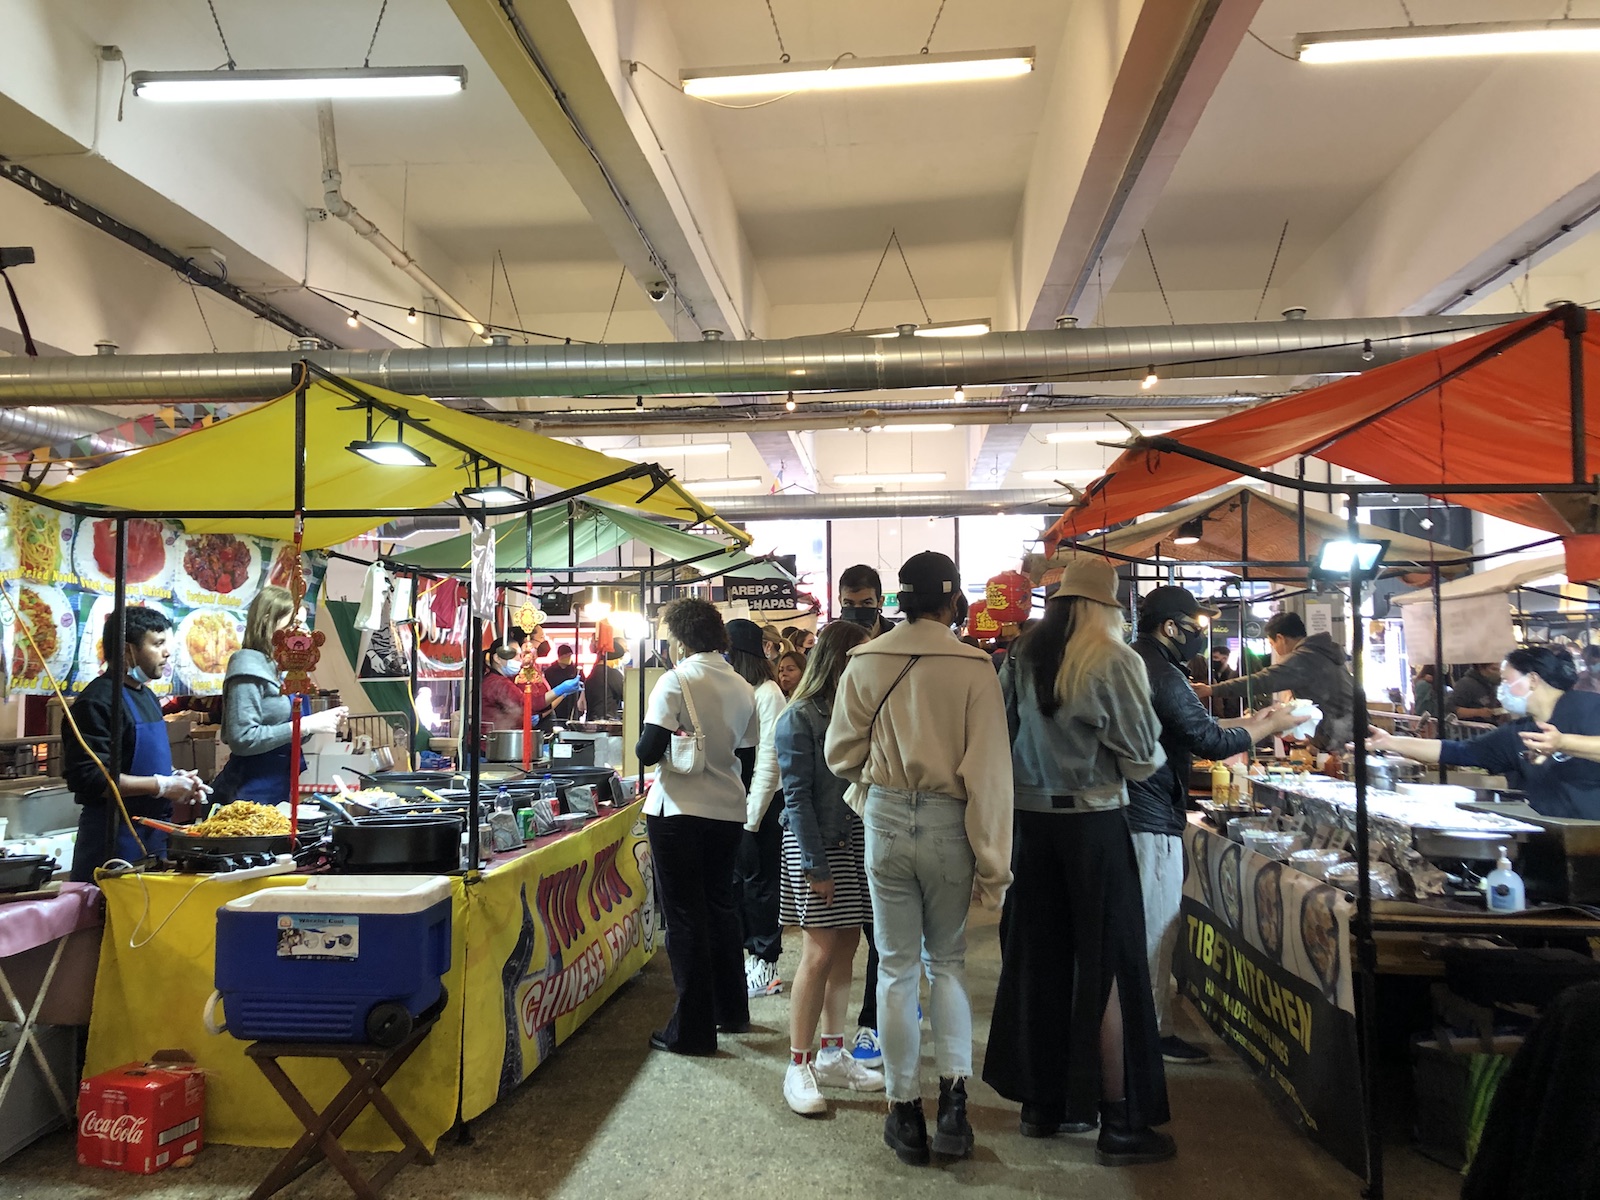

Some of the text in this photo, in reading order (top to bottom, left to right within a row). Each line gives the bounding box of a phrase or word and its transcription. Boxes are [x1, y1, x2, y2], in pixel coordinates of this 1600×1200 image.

[731, 585, 779, 595] AREPAS
[748, 598, 795, 609] CHAPAS
[521, 907, 641, 1039] CHINESE FOOD
[1187, 914, 1232, 980] TIBET
[1232, 945, 1312, 1055] KITCHEN
